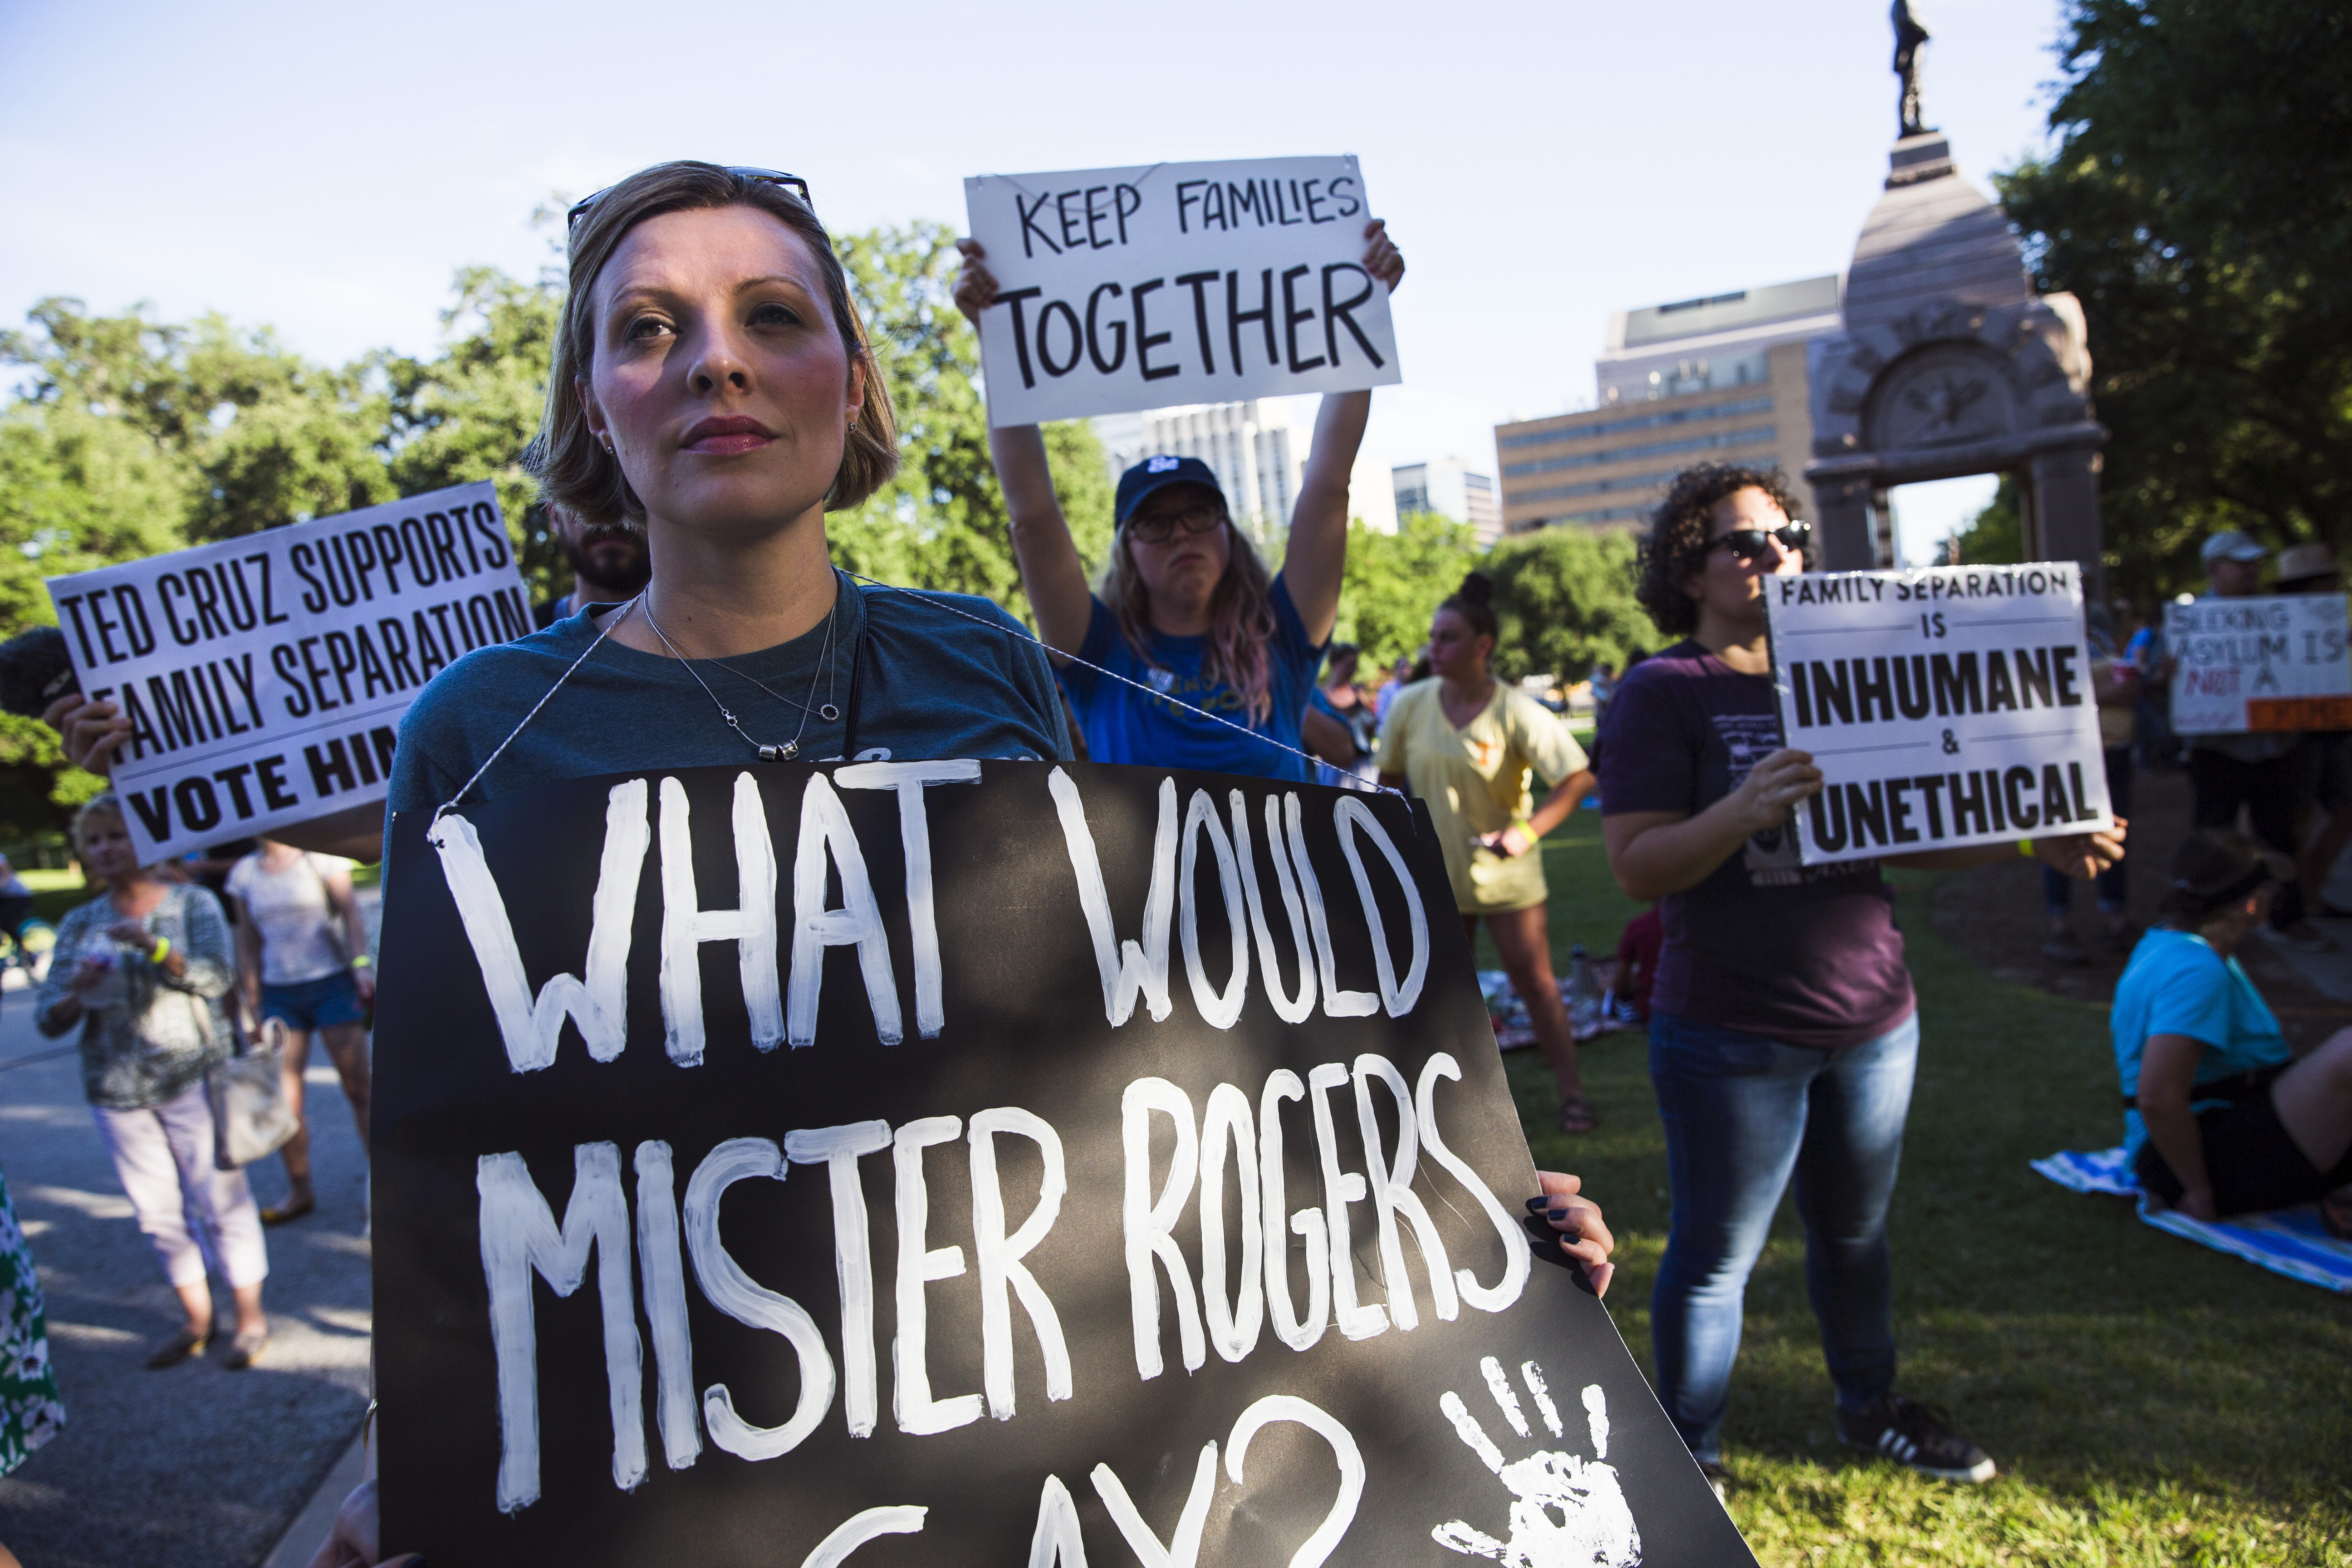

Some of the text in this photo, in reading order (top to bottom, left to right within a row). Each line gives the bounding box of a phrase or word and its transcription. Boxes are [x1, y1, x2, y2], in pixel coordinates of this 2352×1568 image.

[1016, 176, 1360, 258] KEEP FAMILIES
[991, 262, 1386, 389] TOGETHER
[59, 500, 510, 669] TED CRUZ SUPPORTS
[1780, 572, 2067, 605] FAMILY SEPARATION
[1921, 612, 1947, 639] IS
[271, 586, 532, 718] SEPARATION
[1790, 645, 2082, 727] INHUMANE
[2177, 628, 2347, 666] ASYLUM IS
[2251, 666, 2283, 693] A
[1941, 728, 1960, 755] &
[126, 753, 299, 843] VOTE
[1808, 762, 2098, 853] UNETHICAL
[432, 759, 1430, 1074] WHAT WOULD
[477, 1051, 1532, 1514] MISTER ROGERS
